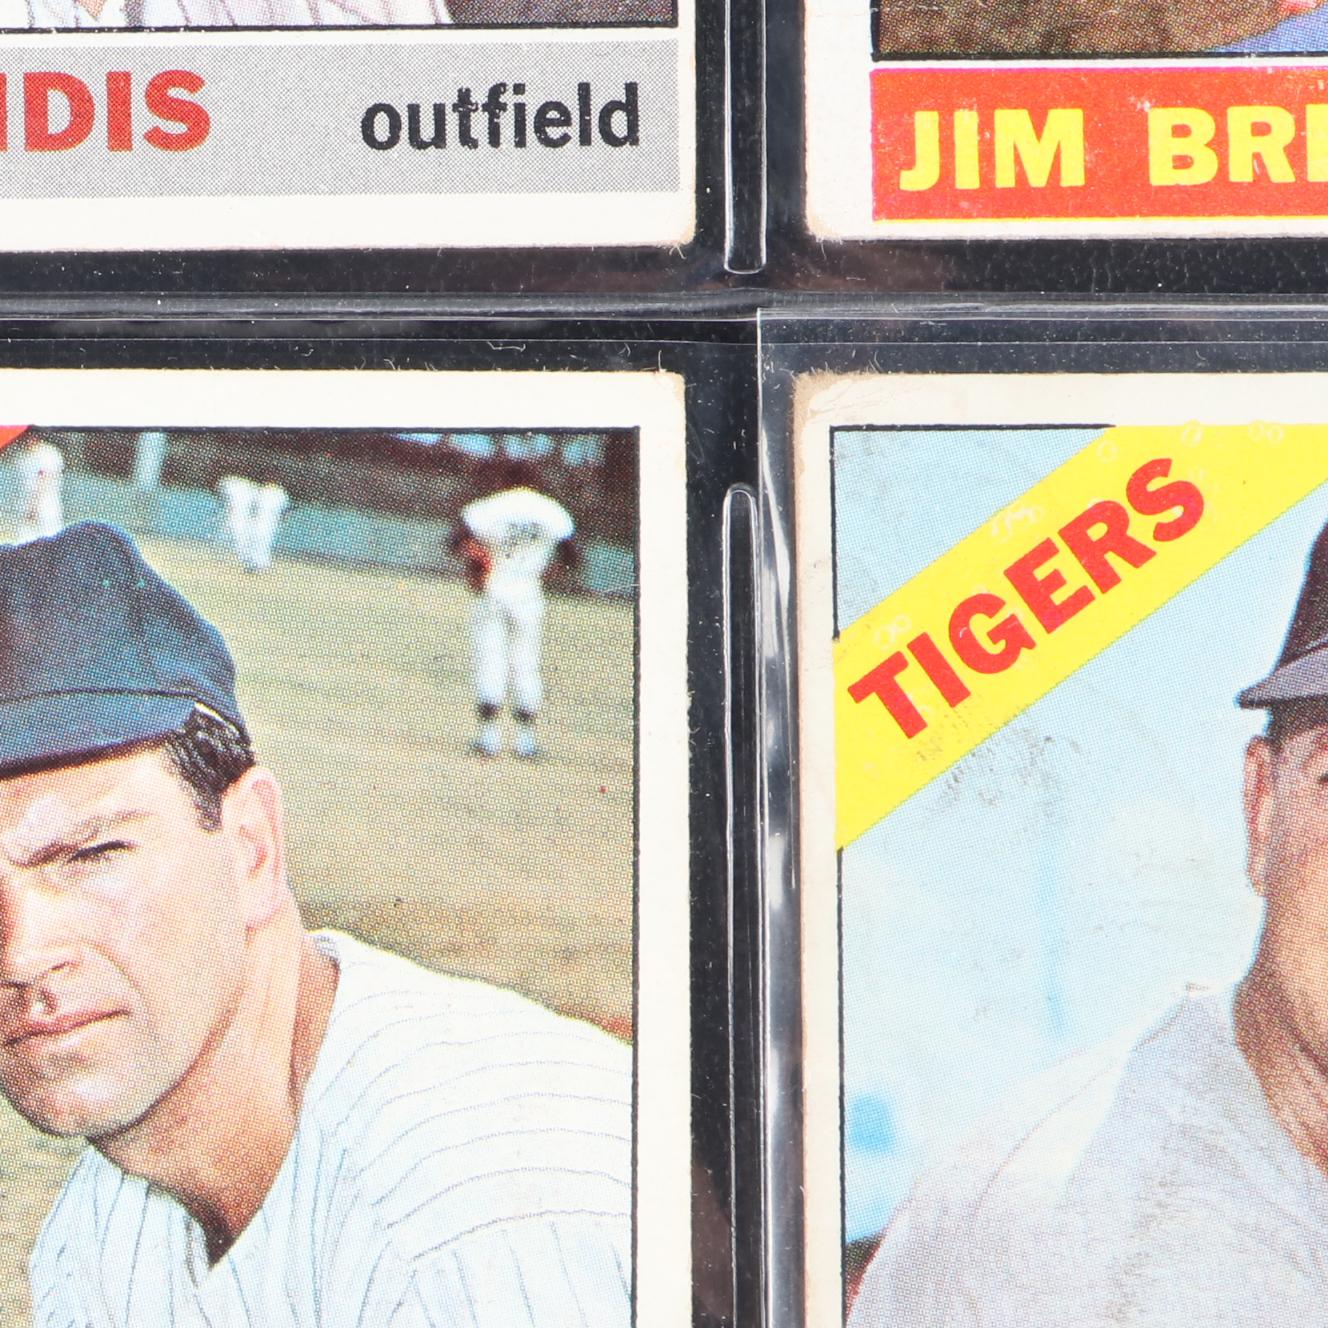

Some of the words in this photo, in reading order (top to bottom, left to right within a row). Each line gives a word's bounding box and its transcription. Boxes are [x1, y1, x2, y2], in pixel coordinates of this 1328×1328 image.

[360, 82, 640, 152] outfield
[898, 107, 1087, 192] JIM
[846, 457, 1206, 740] TIGERS
